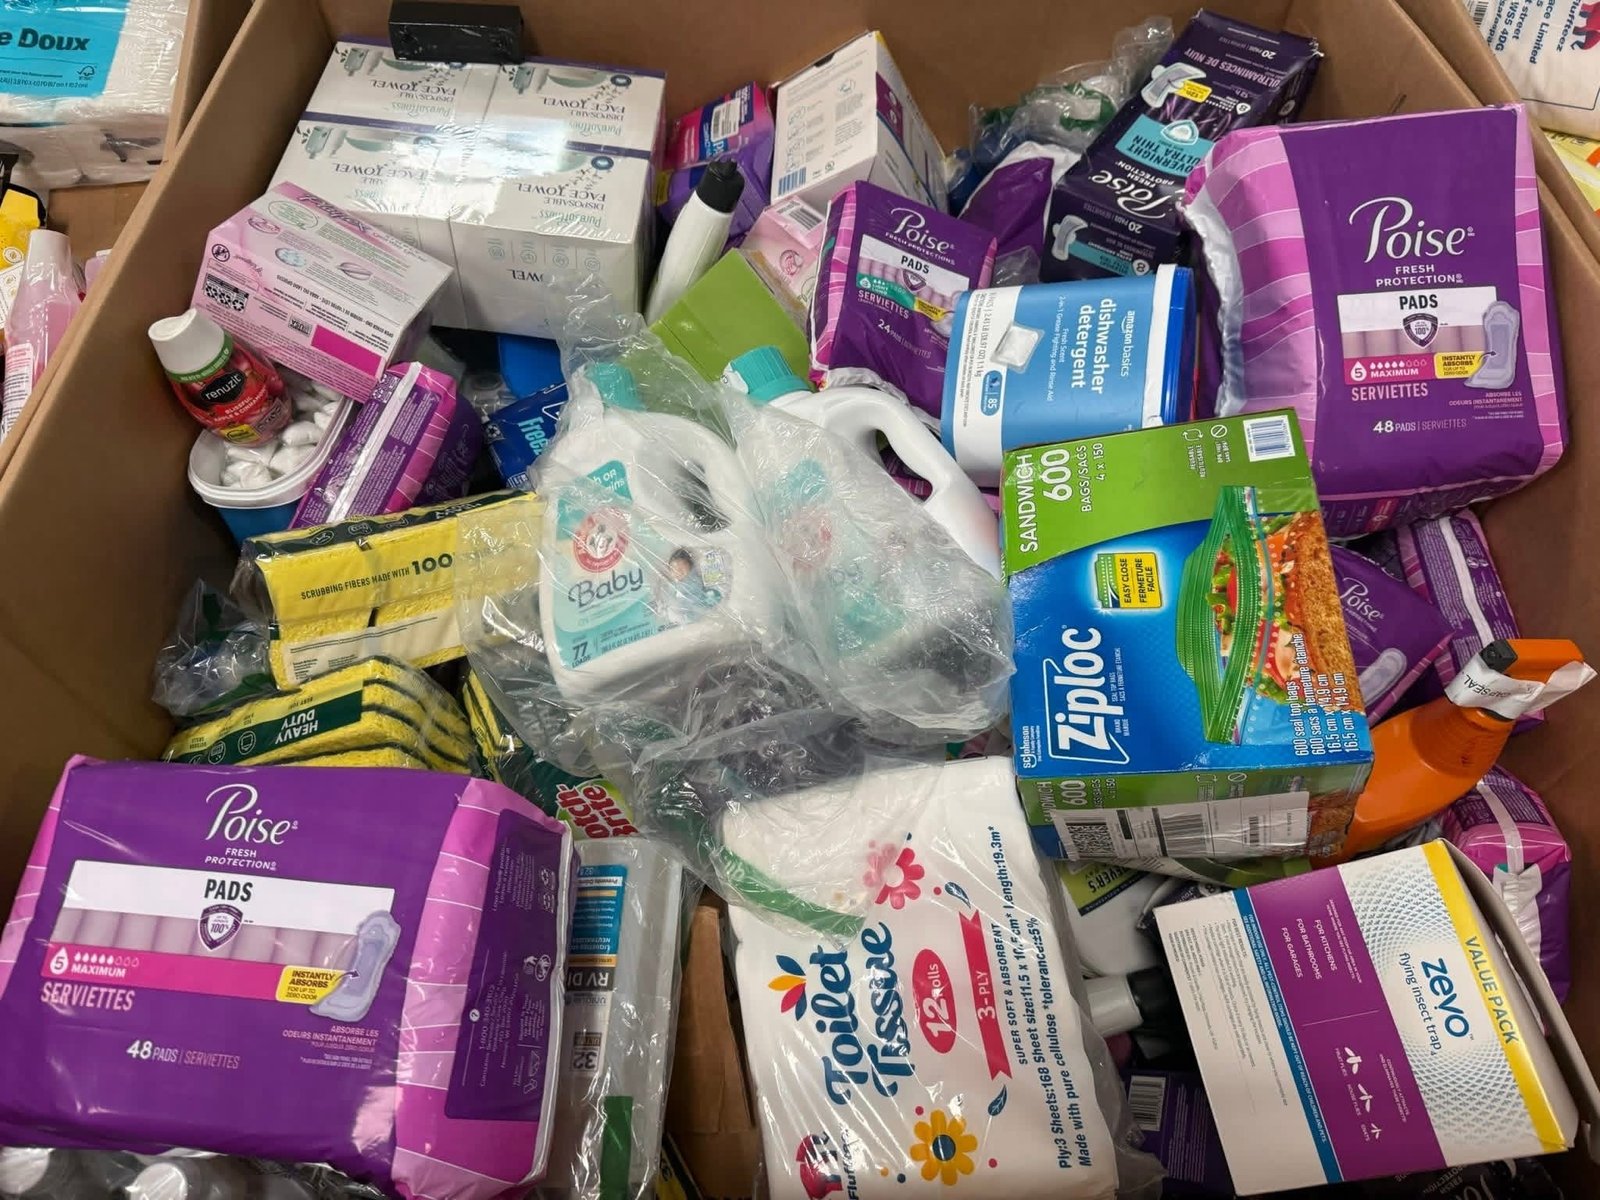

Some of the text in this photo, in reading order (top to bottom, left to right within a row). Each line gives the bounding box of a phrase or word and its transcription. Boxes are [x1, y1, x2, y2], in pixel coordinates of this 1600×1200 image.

[1494, 1, 1520, 52] WS5 4DG
[1512, 5, 1529, 40] street
[1530, 0, 1556, 64] ace Limited
[18, 27, 90, 51] Doux
[1183, 47, 1207, 63] NUIT
[1204, 56, 1220, 67] DE
[1261, 49, 1277, 60] 20
[369, 78, 457, 98] FACE TOWEL
[1218, 61, 1281, 88] ULTRAMINCES
[542, 97, 626, 115] FACE TOWEL
[1127, 143, 1194, 173] OVERNIGHT
[1132, 135, 1201, 165] ULTRA THIN
[334, 162, 383, 176] TOWEL
[1117, 160, 1175, 186] PROTECTION
[1126, 172, 1157, 189] FRESH
[517, 183, 607, 203] FACE TOWEL
[1090, 169, 1172, 219] Poise
[890, 207, 951, 255] Poise
[1127, 220, 1144, 234] 20
[1349, 197, 1466, 263] Poise
[510, 269, 546, 283] WEL
[900, 255, 930, 275] PADS
[1395, 263, 1435, 275] FRESH
[1376, 274, 1456, 287] PROTECTION
[858, 289, 910, 320] SERVIETTES
[1399, 294, 1439, 310] PADS
[877, 318, 891, 334] 24
[1070, 304, 1096, 389] detergent
[1092, 298, 1117, 395] dishwasher
[1121, 310, 1136, 378] amazon basics
[1442, 353, 1476, 362] INSTANTLY
[1354, 367, 1364, 380] 5
[1370, 367, 1419, 379] MAXIMUM
[1443, 358, 1474, 368] ABSORBS
[204, 372, 243, 401] renuzit
[1351, 383, 1429, 402] SERVIETTES
[987, 398, 999, 410] 85
[1373, 418, 1467, 434] 48 PADS SERVIETTES
[1093, 442, 1104, 461] 150
[1040, 448, 1073, 503] 600
[1075, 445, 1094, 513] BAGS/SACS
[1096, 471, 1105, 481] 4
[1016, 453, 1039, 554] SANDWICH
[301, 582, 344, 600] SCRUBBING
[344, 577, 371, 589] FIBERS
[371, 572, 391, 585] MADE
[391, 567, 410, 580] WITH
[568, 566, 644, 610] Baby
[1119, 557, 1132, 604] EASY CLOSE
[1135, 558, 1148, 604] FERMETURE
[1146, 567, 1157, 593] FACILE
[1340, 577, 1381, 622] Poise
[571, 641, 589, 661] 77
[1292, 633, 1308, 665] étanche
[1054, 627, 1124, 750] Ziploc
[1300, 666, 1317, 706] fermeture
[1317, 674, 1329, 687] cm
[1333, 672, 1345, 685] cm
[1317, 689, 1333, 708] 14.9
[1333, 688, 1350, 707] 14,9
[281, 707, 316, 731] DUTY
[1286, 681, 1310, 756] 600 seal top bags
[1309, 716, 1321, 736] sacs
[1326, 718, 1339, 732] cm
[1342, 717, 1355, 731] cm
[274, 719, 319, 746] HEAVY
[1325, 733, 1343, 753] 16.5
[1342, 732, 1359, 753] 16,5
[1310, 738, 1326, 755] 600
[1060, 779, 1087, 807] 600
[205, 783, 291, 846] Poise
[556, 784, 610, 839] otch-
[204, 856, 271, 871] PROTECTION
[225, 848, 257, 859] FRESH
[203, 878, 253, 903] PADS
[1088, 865, 1128, 894] EYER'S
[1281, 927, 1304, 978] FOR GARAGES
[1296, 918, 1323, 980] FOR BATHROOMS
[1315, 919, 1338, 972] FOR KITCHENS
[54, 955, 65, 971] 5
[71, 965, 127, 979] MAXIMUM
[292, 970, 335, 981] INSTANTLY
[1020, 964, 1029, 972] x
[289, 978, 329, 989] ABSORBS
[568, 970, 608, 988] RV DI
[1464, 935, 1520, 1045] VALUE PACK
[41, 981, 136, 1012] SERVIETTES
[975, 970, 997, 1021] 3-PLY
[991, 923, 1028, 1065] SUPER SOFT & ABSORBENT
[1020, 975, 1040, 1027] size:11.5
[1399, 953, 1444, 1052] flying insect trap
[1421, 958, 1471, 1039] zevo
[860, 920, 916, 1098] Tissue
[922, 997, 951, 1038] 12
[282, 1029, 311, 1040] ODEURS
[330, 1025, 380, 1037] ABSORBE LES
[808, 944, 869, 1106] Toilet
[1032, 1028, 1046, 1064] Sheet
[1049, 1012, 1066, 1068] cellulose
[126, 1039, 241, 1070] 48 PADS SERVIETTES
[572, 1050, 598, 1070] 32
[1038, 1066, 1064, 1134] Sheets:168
[1065, 1071, 1081, 1103] pure
[1071, 1104, 1085, 1131] with
[1054, 1133, 1072, 1169] Ply:3
[1077, 1133, 1093, 1167] Made
